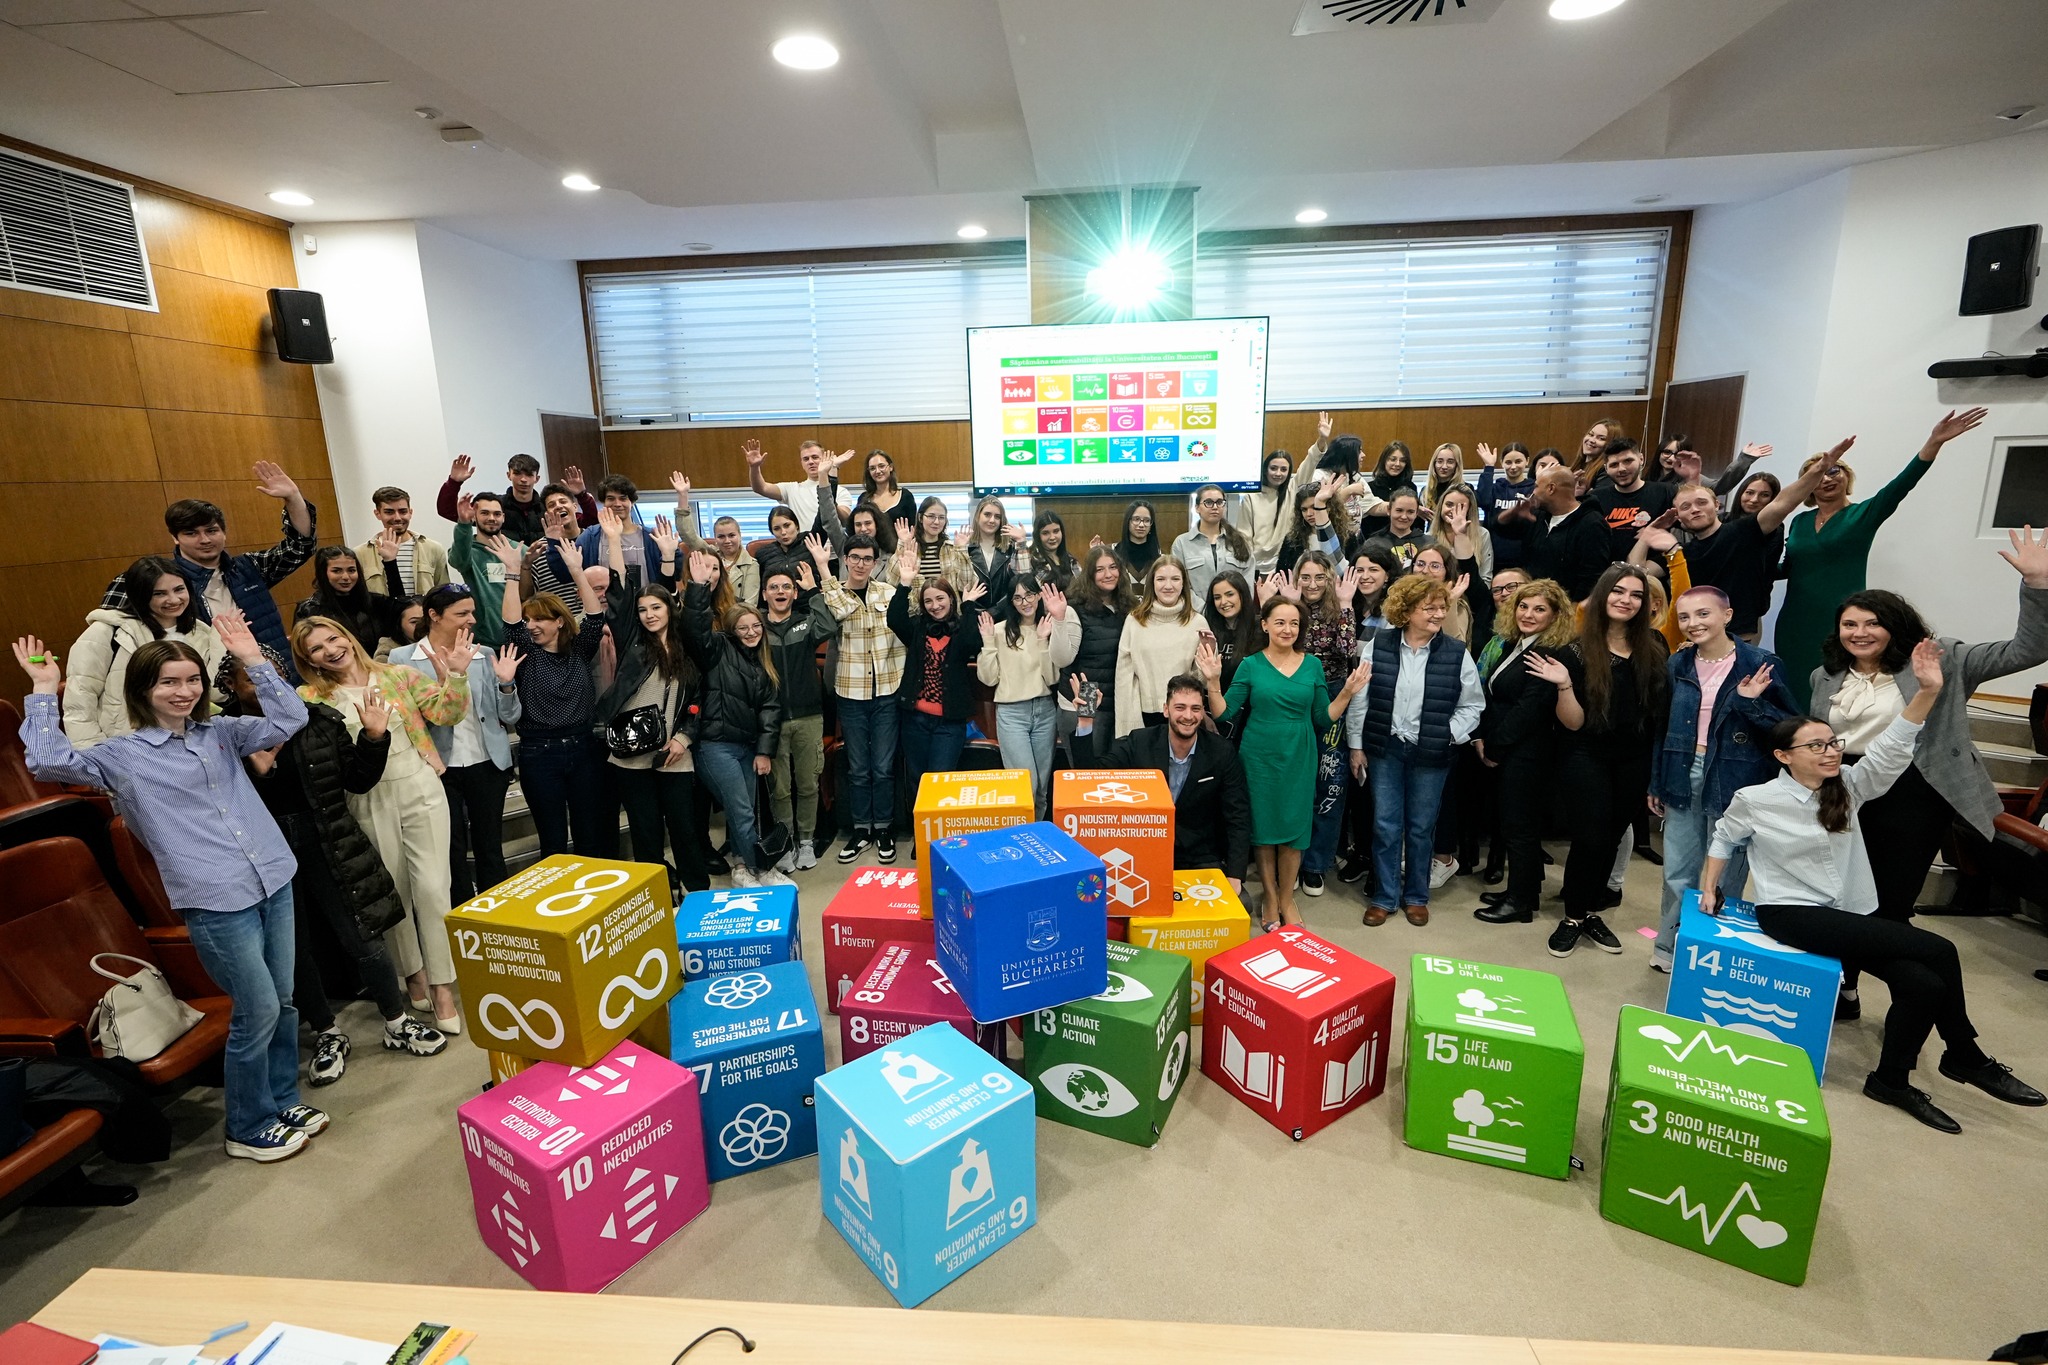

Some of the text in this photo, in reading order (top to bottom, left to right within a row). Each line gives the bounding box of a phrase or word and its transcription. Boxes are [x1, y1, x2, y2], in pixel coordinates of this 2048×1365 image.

[1608, 507, 1640, 520] NIKE
[930, 773, 950, 783] 11
[1062, 772, 1076, 780] 9
[921, 816, 944, 843] 11
[945, 815, 1027, 828] SUSTAINABLE CITIES
[1063, 814, 1078, 838] 9
[1079, 814, 1168, 825] INDUSTRY, INNOVATION
[1079, 828, 1168, 838] AND INFRASTRUCTURE
[1019, 832, 1061, 865] BUCHAREST
[461, 896, 508, 913] 12
[515, 889, 537, 900] AND
[603, 887, 651, 930] RESPONSIBLE
[605, 900, 655, 943] CONSUMPTION
[699, 916, 754, 926] INSTITUTIONS
[609, 907, 666, 959] AND PRODUCTION
[686, 931, 718, 939] JUSTICE
[736, 921, 753, 929] AND
[755, 918, 782, 933] 16
[830, 922, 841, 946] 1
[841, 926, 853, 936] NO
[1160, 927, 1230, 940] AFFORDABLE AND
[1278, 931, 1304, 943] 4
[453, 929, 484, 961] 12
[482, 932, 541, 951] RESPONSIBLE
[576, 923, 604, 965] 12
[739, 944, 772, 957] JUSTICE
[842, 937, 875, 948] POVERTY
[1142, 929, 1159, 949] 7
[1159, 939, 1219, 951] CLEAN ENERGY
[1302, 937, 1337, 955] QUALITY
[485, 947, 546, 966] CONSUMPTION
[708, 957, 761, 971] AND STRONG
[1001, 946, 1085, 973] UNIVERSITY OF
[1293, 941, 1337, 965] EDUCATION
[1421, 957, 1455, 975] 15
[1686, 944, 1723, 977] 14
[1731, 955, 1756, 971] LIFE
[489, 961, 562, 983] AND PRODUCTION
[864, 970, 884, 989] DECENT
[1002, 955, 1085, 984] BUCHAREST
[1458, 962, 1480, 972] LIFE
[1459, 969, 1504, 983] ON LAND
[1210, 977, 1227, 1005] 4
[1729, 967, 1812, 998] BELOW WATER
[854, 990, 886, 1004] 8
[1228, 986, 1257, 1010] QUALITY
[692, 1017, 769, 1039] FOR THE GOALS
[777, 1009, 808, 1031] 17
[873, 1020, 906, 1034] DECENT
[1034, 1009, 1057, 1036] 13
[1062, 1012, 1101, 1032] CLIMATE
[1228, 1001, 1266, 1030] EDUCATION
[1331, 1014, 1365, 1041] EDUCATION
[1332, 1004, 1359, 1026] QUALITY
[695, 1025, 771, 1048] PARTNERSHIPS
[850, 1016, 870, 1044] 8
[1062, 1028, 1096, 1046] ACTION
[1156, 1014, 1166, 1052] 13
[1313, 1018, 1330, 1047] 4
[720, 1044, 796, 1073] PARTNERSHIPS
[1423, 1032, 1459, 1064] 15
[1464, 1038, 1489, 1054] LIFE
[721, 1058, 799, 1087] FOR THE GOALS
[1463, 1053, 1513, 1072] ON LAND
[686, 1062, 713, 1095] 7
[982, 1072, 1013, 1095] 6
[1647, 1064, 1767, 1103] AND WELL-BEING
[904, 1082, 980, 1127] AND SANITATION
[1675, 1081, 1769, 1113] GOOD HEALTH
[508, 1095, 562, 1128] INEQUALITIES
[925, 1091, 991, 1130] CLEAN WATER
[1629, 1100, 1659, 1134] 3
[1775, 1099, 1808, 1125] 3
[501, 1113, 543, 1141] REDUCED
[601, 1114, 652, 1157] REDUCED
[1665, 1110, 1760, 1149] GOOD HEALTH
[461, 1122, 482, 1159] 10
[483, 1135, 515, 1167] REDUCED
[539, 1125, 585, 1156] 10
[603, 1119, 674, 1176] INEQUALITIES
[1662, 1127, 1788, 1173] AND WELL-BEING
[487, 1153, 531, 1195] INEQUALITIES
[557, 1155, 594, 1201] 10
[834, 1193, 881, 1254] AND SANITATION
[1008, 1195, 1028, 1229] 6
[842, 1216, 882, 1270] CLEAN WATER
[934, 1207, 1006, 1266] AND SANITATION
[946, 1222, 1006, 1273] CLEAN WATER
[883, 1251, 899, 1290] 6
